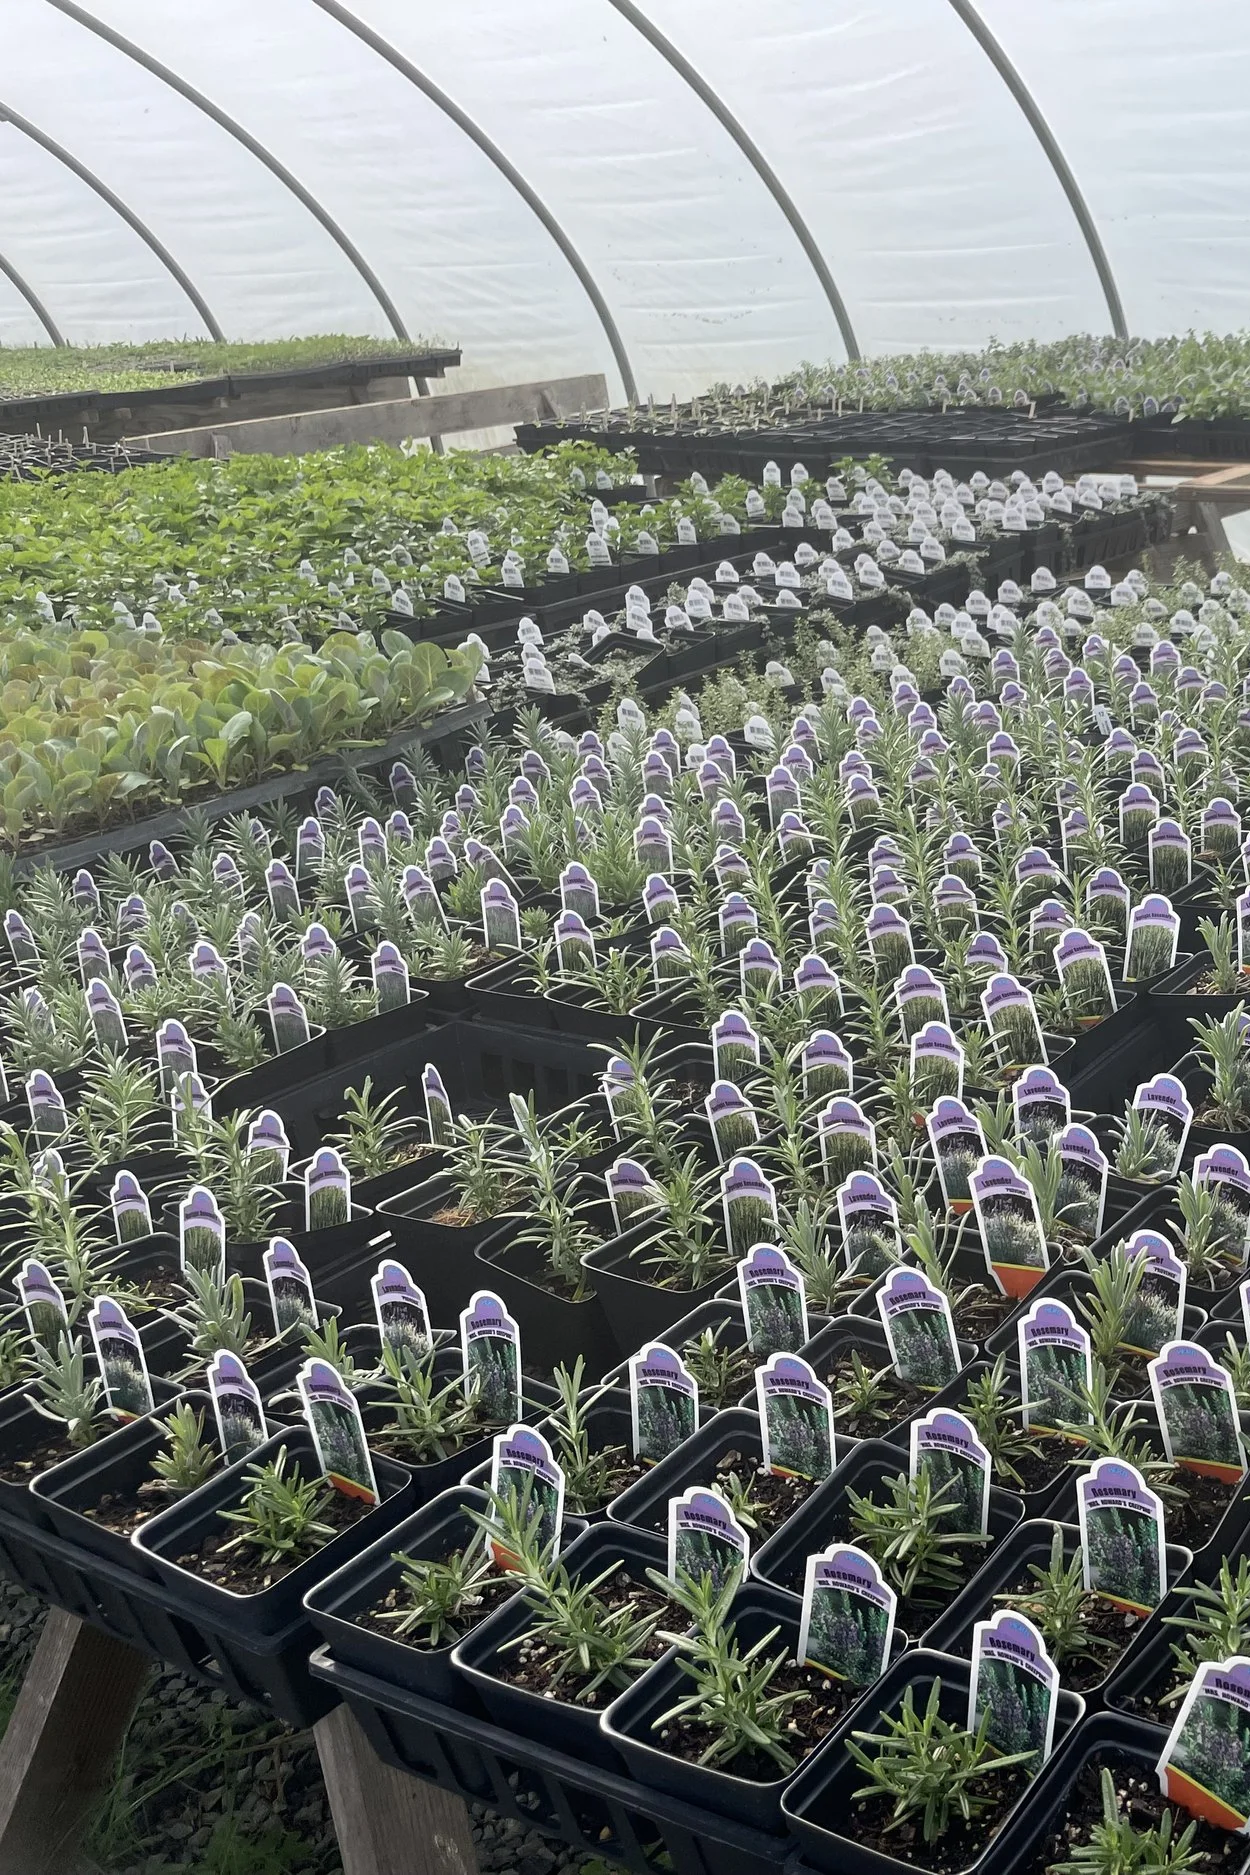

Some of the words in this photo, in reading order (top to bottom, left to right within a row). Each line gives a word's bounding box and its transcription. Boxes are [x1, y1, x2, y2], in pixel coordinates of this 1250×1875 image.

[1024, 1086, 1051, 1096] Lavender
[1147, 1093, 1176, 1104] Lavender
[937, 1117, 963, 1128] Lavender
[1062, 1143, 1090, 1155] Lavender
[981, 1177, 1011, 1188] Lavender
[848, 1193, 876, 1202] Lavender
[749, 1268, 784, 1277] Rosemary
[889, 1291, 926, 1305] Rosemary
[471, 1318, 502, 1329] Rosemary
[1030, 1326, 1069, 1336] Rosemary
[642, 1368, 678, 1380] Rosemary
[1163, 1366, 1206, 1377] Rosemary
[769, 1377, 809, 1390] Rosemary
[925, 1431, 969, 1448] Rosemary
[506, 1448, 544, 1468] Rosemary
[1091, 1487, 1137, 1499] Rosemary
[683, 1510, 726, 1530] Rosemary
[824, 1568, 872, 1589] Rosemary
[989, 1637, 1035, 1662] Rosemary
